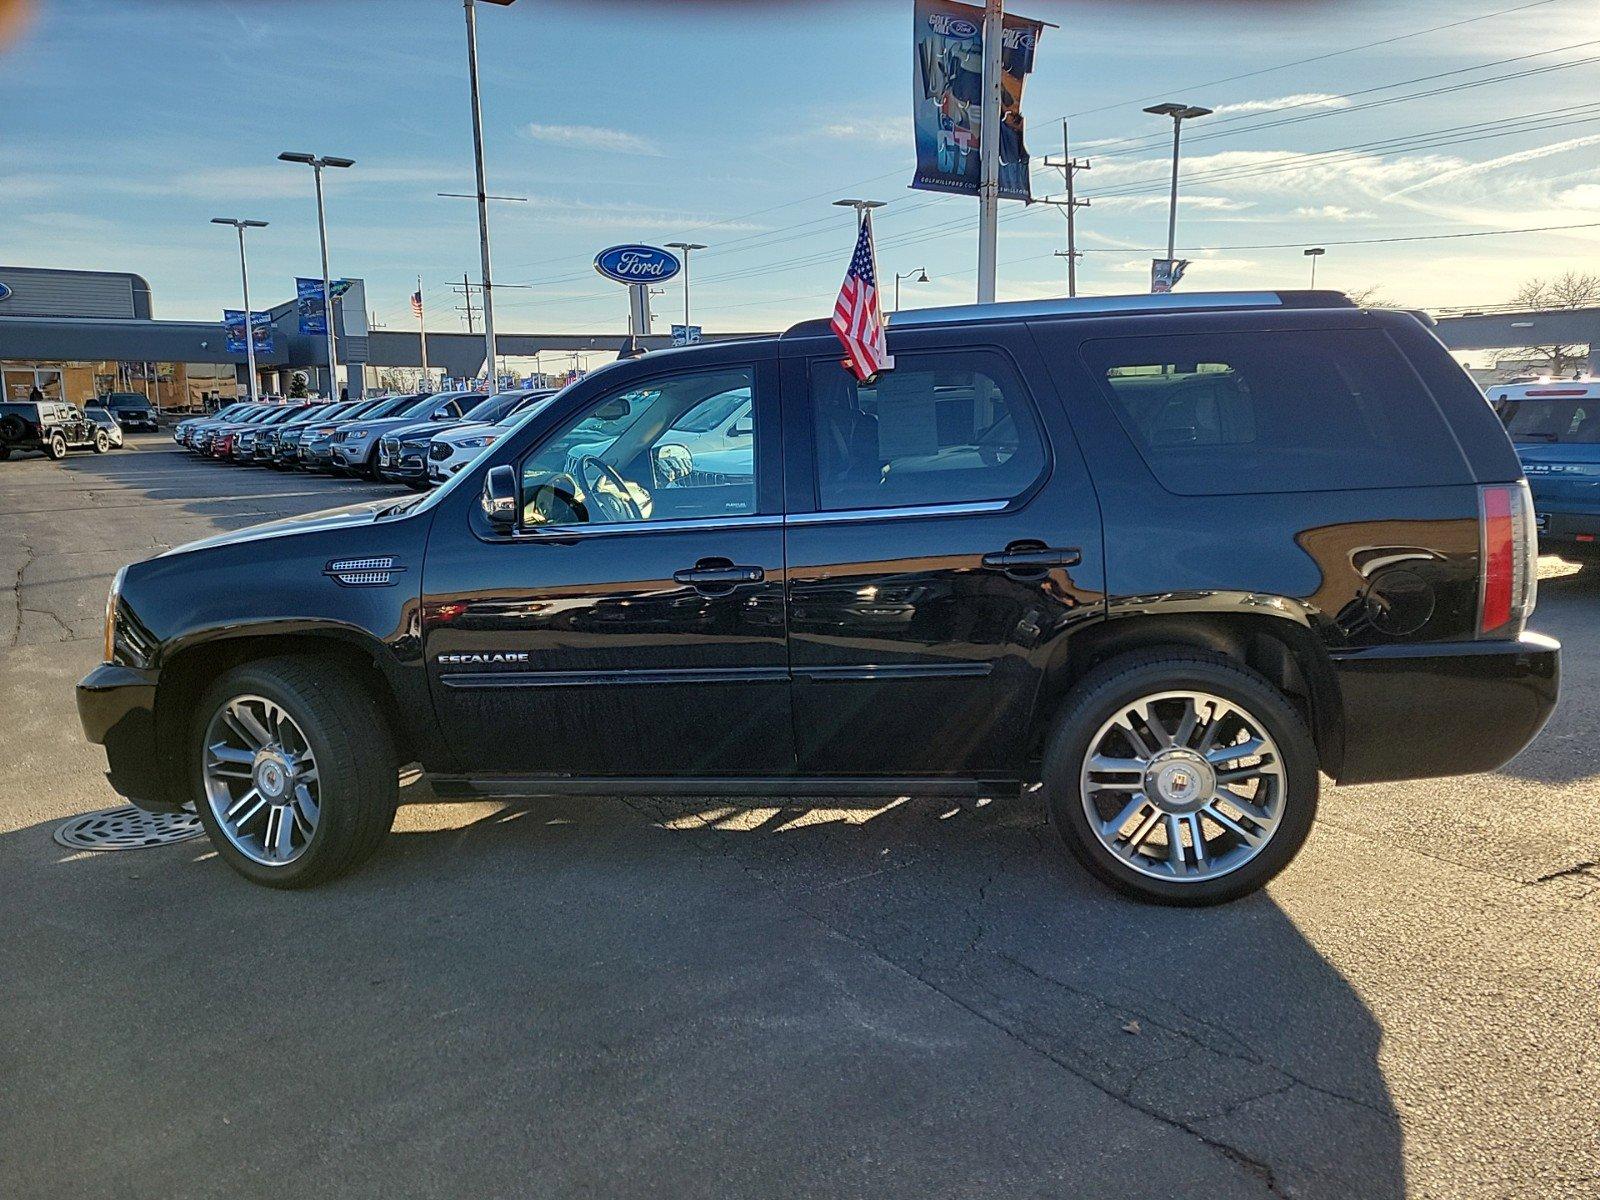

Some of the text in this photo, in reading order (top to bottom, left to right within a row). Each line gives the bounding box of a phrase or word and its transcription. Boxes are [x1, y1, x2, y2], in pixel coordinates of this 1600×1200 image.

[929, 14, 951, 27] GOLF
[933, 23, 950, 36] MILL
[1002, 28, 1023, 42] GOLF
[617, 251, 664, 275] Ford
[438, 653, 529, 664] ESCALADE
